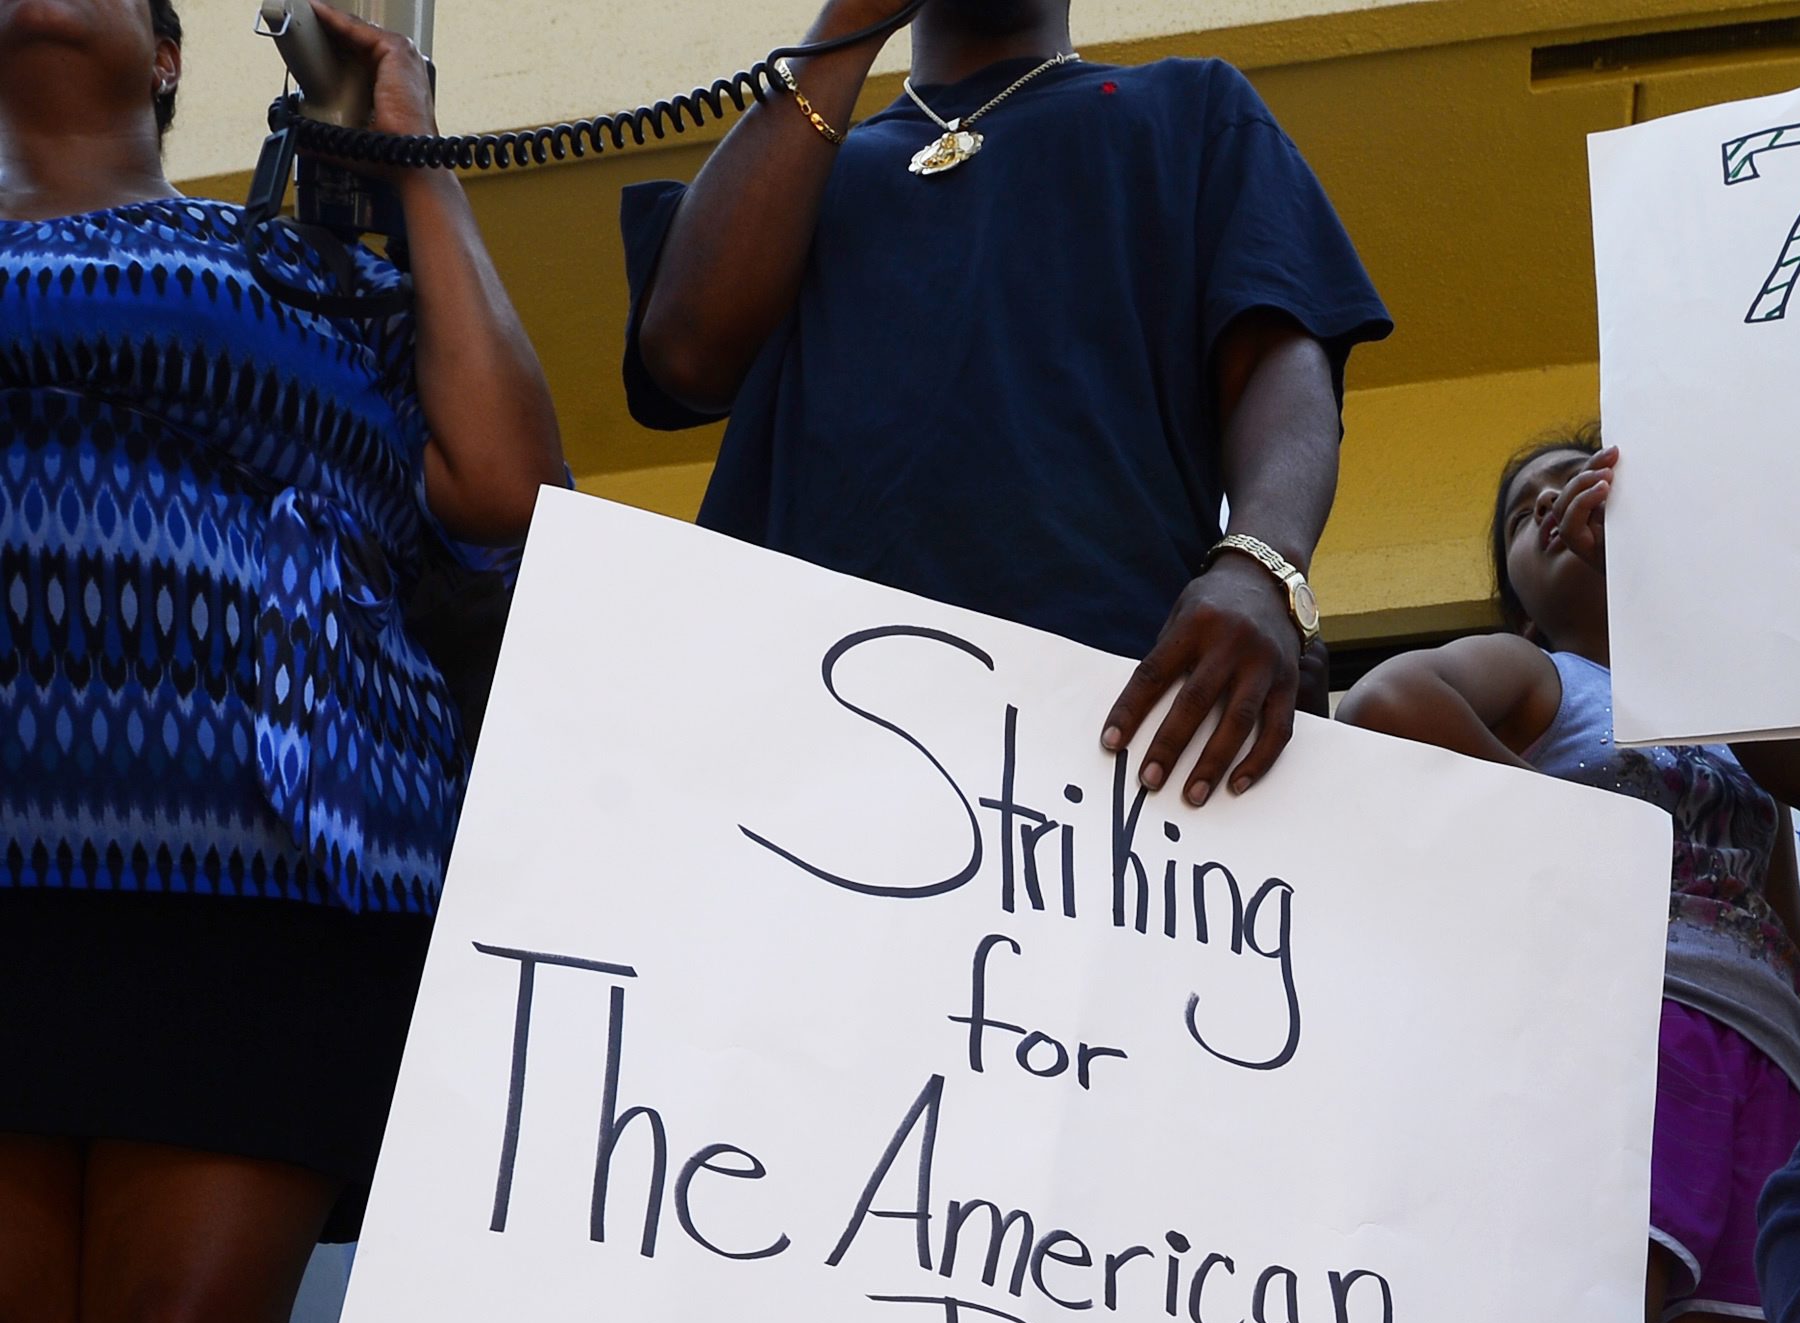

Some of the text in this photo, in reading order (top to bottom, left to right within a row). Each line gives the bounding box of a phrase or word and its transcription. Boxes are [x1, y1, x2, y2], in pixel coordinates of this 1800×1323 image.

[738, 625, 1300, 1070] Striking
[472, 942, 790, 1259] The
[948, 935, 1127, 1090] for
